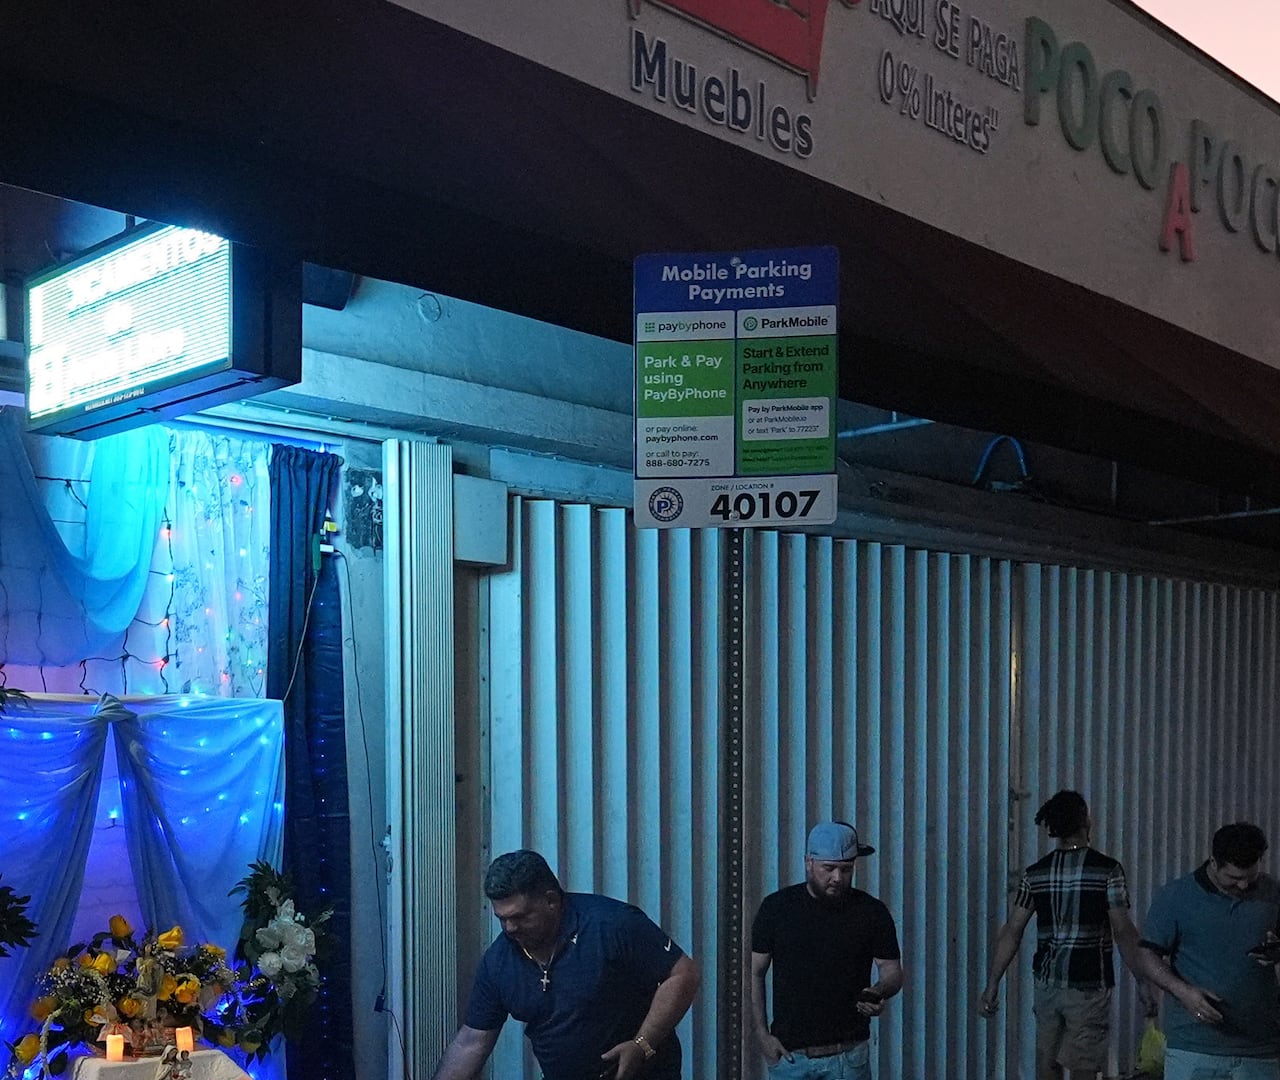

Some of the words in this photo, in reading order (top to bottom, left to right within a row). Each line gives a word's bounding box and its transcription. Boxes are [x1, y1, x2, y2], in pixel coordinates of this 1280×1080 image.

[936, 0, 961, 58] SE
[967, 16, 1021, 91] PAGA
[631, 27, 815, 158] Muebles
[1024, 15, 1164, 191] POCO
[1158, 160, 1196, 263] A
[661, 263, 729, 282] Mobile
[734, 260, 812, 281] Parking
[688, 283, 785, 304] Payments
[658, 320, 727, 333] paybyphone
[761, 316, 829, 329] ParkMobile
[743, 346, 773, 359] Start
[776, 346, 784, 357] &
[786, 344, 829, 358] Extend
[644, 355, 676, 368] Park
[681, 355, 691, 367] &
[696, 355, 722, 370] Pay
[742, 362, 791, 376] Parking
[793, 361, 823, 373] from
[644, 372, 683, 386] using
[743, 377, 807, 391] Anywhere
[644, 388, 727, 402] PayByPhone
[646, 434, 719, 443] paybyphone.com
[710, 490, 821, 521] 40107
